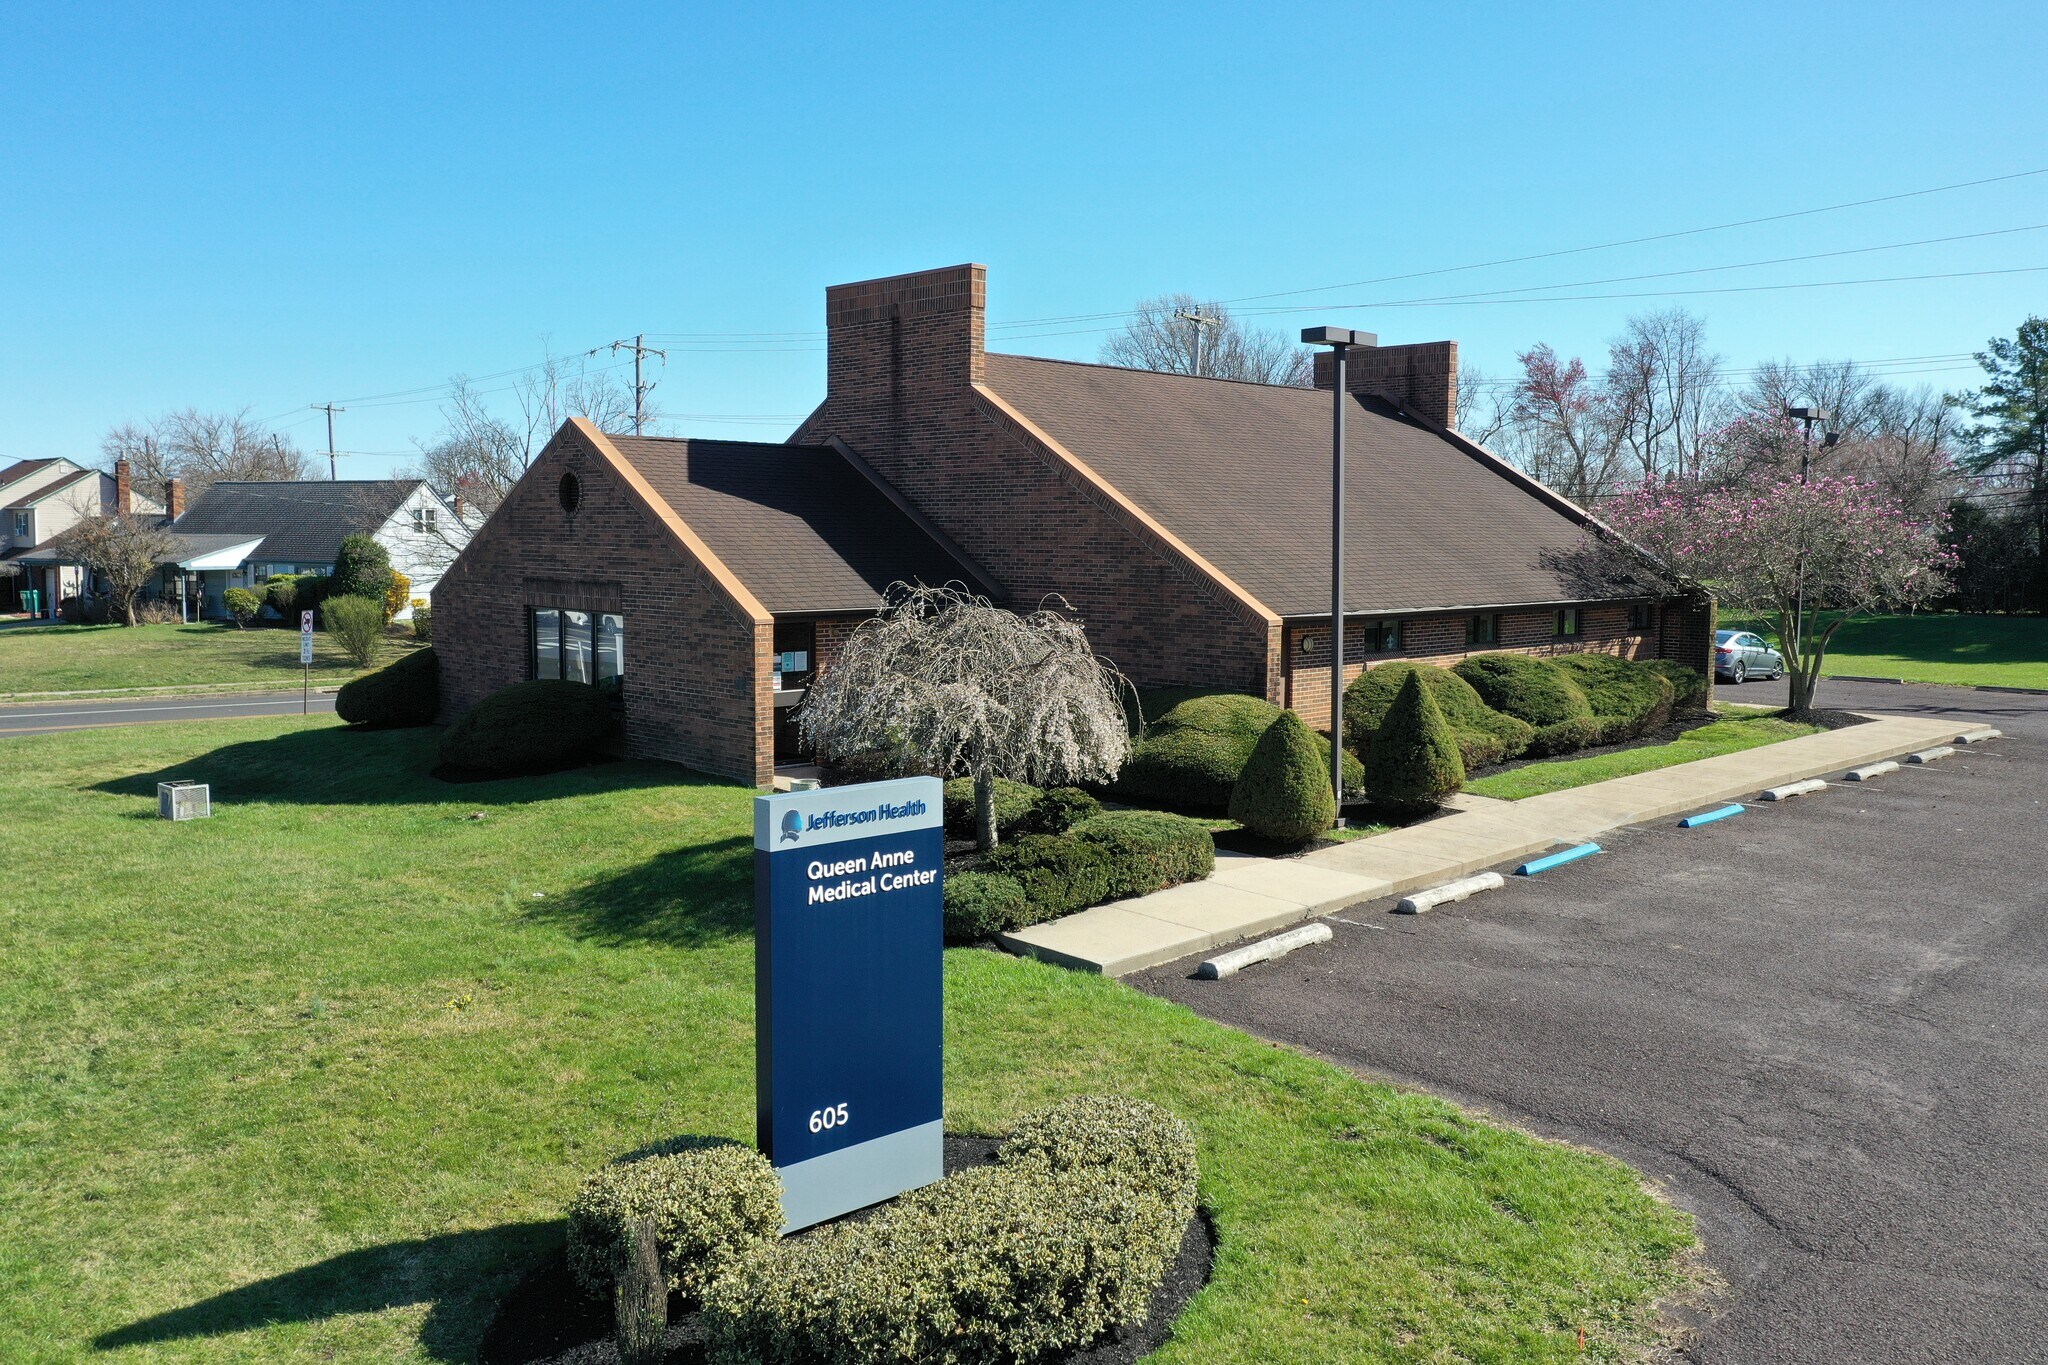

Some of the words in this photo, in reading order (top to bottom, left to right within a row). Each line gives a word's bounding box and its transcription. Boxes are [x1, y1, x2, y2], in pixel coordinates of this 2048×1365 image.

[806, 809, 876, 832] Jefferson
[879, 799, 926, 821] Health
[807, 857, 866, 880] Queen
[871, 850, 914, 870] Anne
[808, 876, 876, 905] Medical
[880, 869, 937, 892] Center
[809, 1102, 849, 1133] 605
